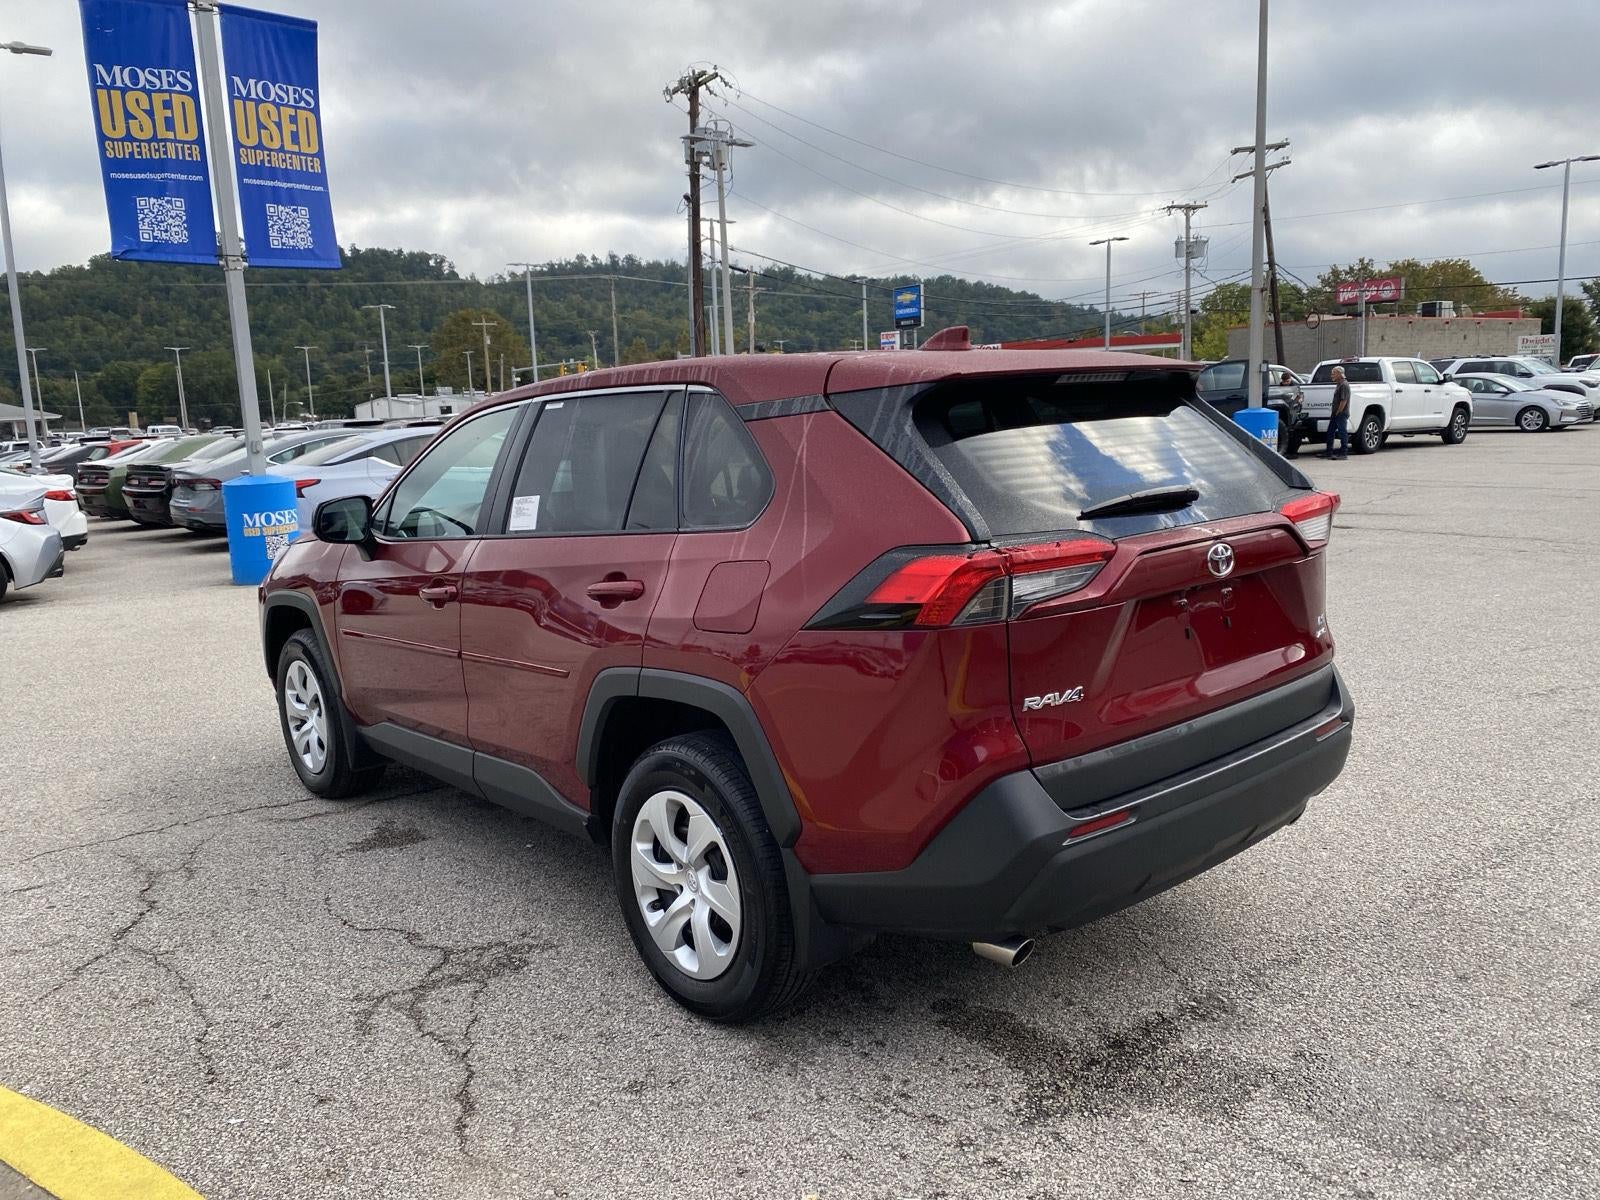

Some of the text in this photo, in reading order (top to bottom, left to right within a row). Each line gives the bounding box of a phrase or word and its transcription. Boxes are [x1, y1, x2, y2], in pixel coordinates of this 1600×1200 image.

[93, 64, 193, 92] MOSES
[231, 76, 315, 109] MOSES
[97, 89, 199, 141] USED
[234, 99, 319, 154] USED
[104, 141, 201, 161] SUPERCENTER
[240, 148, 322, 173] SUPERCENTER
[110, 172, 204, 181] mosesusedsupercenter.com
[243, 178, 324, 192] mosesusedsupercenter.com
[242, 509, 298, 528] MOSES
[1022, 686, 1084, 712] RAV4
